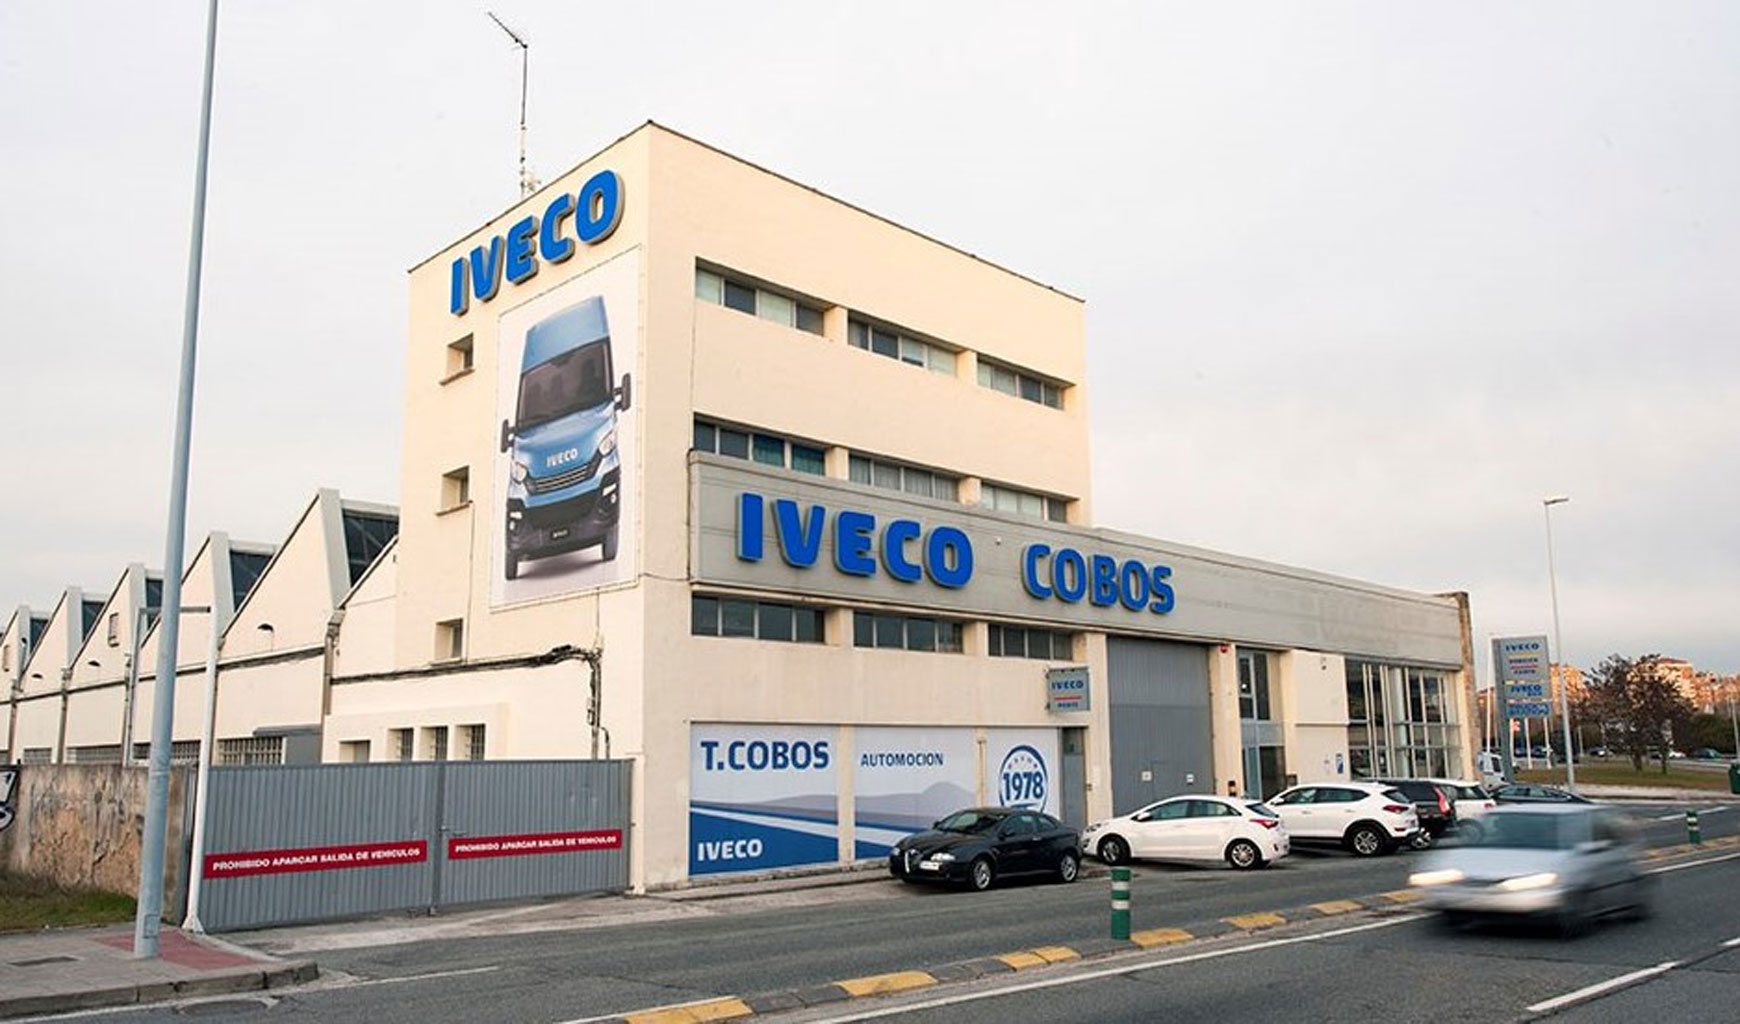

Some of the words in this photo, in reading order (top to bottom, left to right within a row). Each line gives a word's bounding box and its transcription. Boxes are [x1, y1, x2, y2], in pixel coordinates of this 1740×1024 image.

[449, 169, 625, 317] IVECO
[546, 447, 579, 468] IVECO
[736, 492, 974, 589] IVECO
[1022, 543, 1176, 614] COBOS
[1505, 643, 1541, 652] IVECO
[1051, 680, 1084, 690] IVECO
[700, 740, 830, 771] T.COBOS
[860, 752, 944, 768] AUTOMOCION
[1003, 771, 1044, 800] 1978
[455, 842, 499, 853] PROHIBIDO
[501, 840, 537, 850] APARCAR
[538, 838, 564, 848] SALIDA
[566, 838, 576, 846] DE
[578, 836, 617, 845] VEHICULOS
[697, 838, 763, 862] IVECO
[212, 858, 270, 871] PROHIBIDO
[272, 855, 318, 866] APARCAR
[320, 852, 354, 863] SALIDA
[355, 851, 369, 860] DE
[371, 847, 420, 859] VEHICULOS
